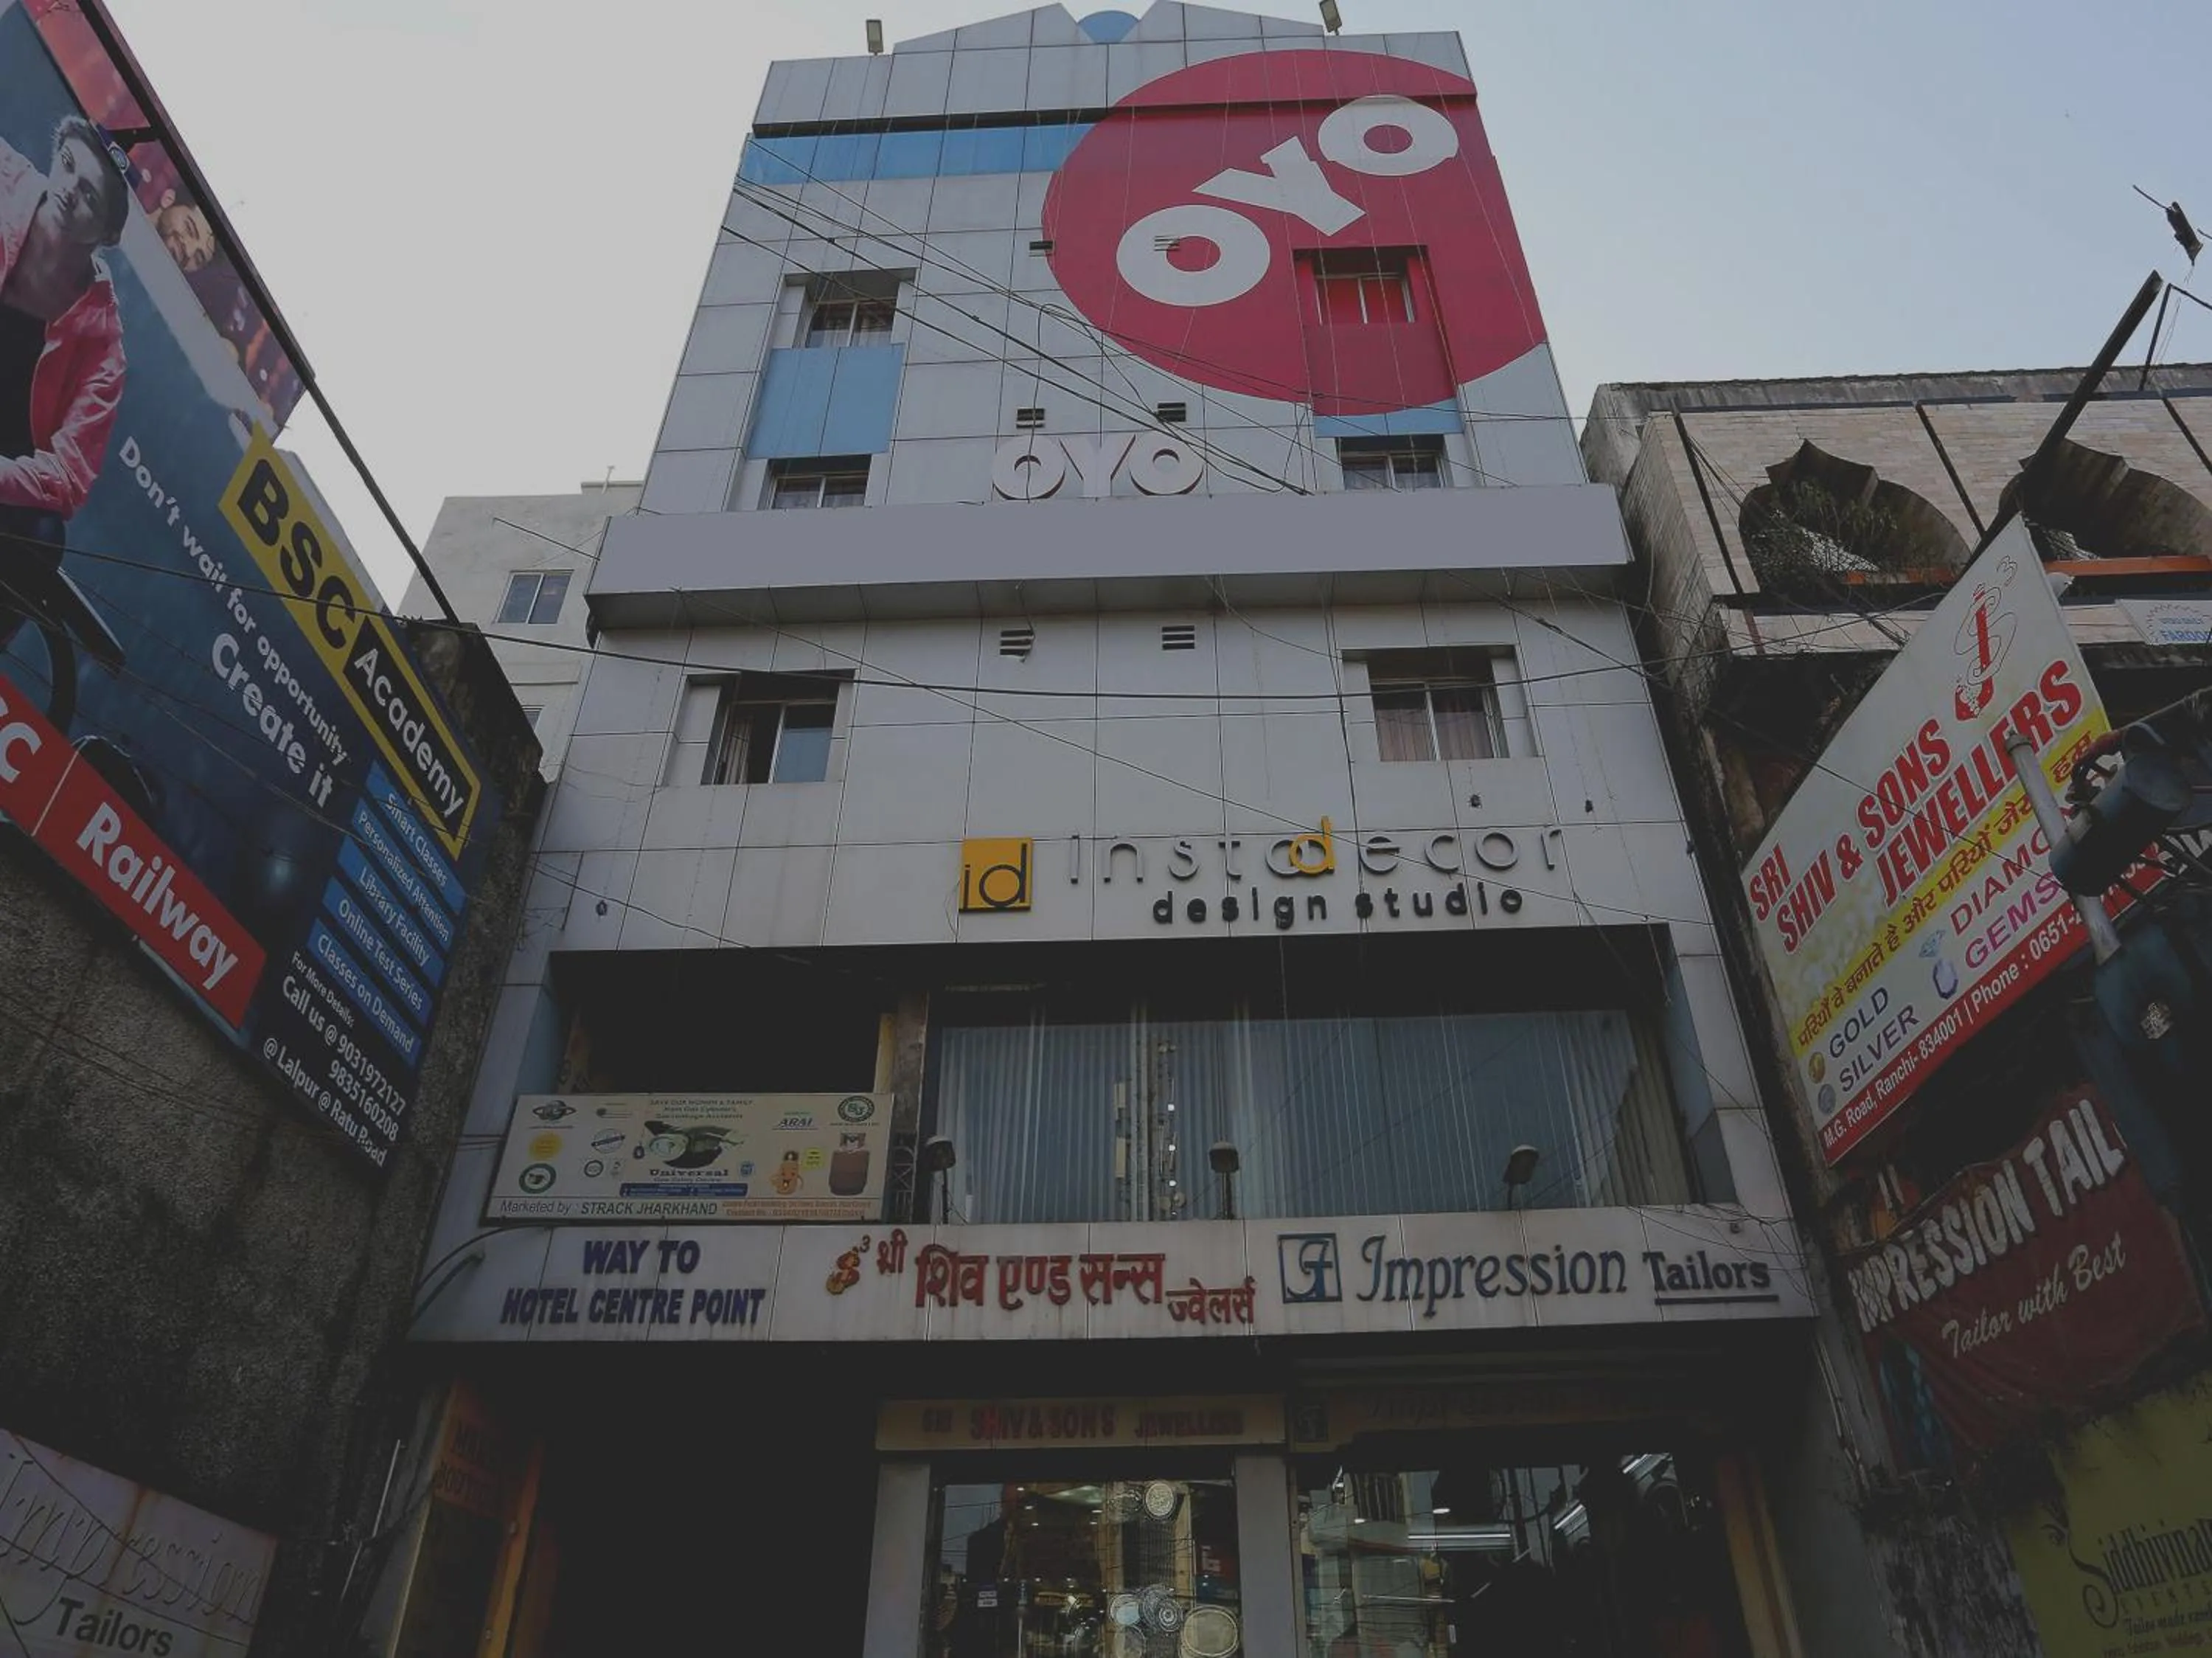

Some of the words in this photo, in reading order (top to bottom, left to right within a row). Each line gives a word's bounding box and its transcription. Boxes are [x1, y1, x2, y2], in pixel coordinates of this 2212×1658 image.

[1116, 94, 1459, 307] OYO
[992, 434, 1203, 500] OYO
[119, 436, 179, 526] Don't
[183, 525, 229, 592] wait
[227, 588, 257, 634] for
[257, 635, 349, 767] opportunity
[237, 458, 355, 650] BSC
[212, 632, 306, 774] Create
[308, 763, 333, 808] it
[354, 648, 465, 818] Academy
[1874, 660, 2082, 906] JEWELLERS
[0, 690, 42, 783] C
[76, 802, 239, 991] Railway
[359, 810, 414, 892] Personalized
[413, 884, 451, 941] Attention
[385, 792, 417, 842] Smart
[414, 834, 448, 888] Classes
[961, 842, 1028, 909] id
[1749, 845, 1792, 920] SRI
[1776, 853, 1837, 954] SHIV
[1835, 833, 1864, 881] &
[1857, 718, 1952, 850] SONS
[338, 898, 375, 949] Online
[374, 939, 395, 976] Test
[393, 966, 423, 1013] Series
[359, 866, 397, 923] Library
[395, 912, 431, 968] Facility
[1153, 889, 1328, 930] design
[1354, 880, 1524, 920] studio
[1964, 869, 2062, 971] GEMS
[291, 950, 307, 977] For
[305, 969, 327, 999] More
[317, 934, 358, 990] Classes
[357, 982, 372, 1007] on
[372, 996, 414, 1054] Demand
[1829, 987, 1888, 1058] GOLD
[282, 975, 310, 1013] Call
[307, 1005, 327, 1034] us
[338, 1033, 407, 1117] 9031972127
[1823, 1120, 1847, 1148] M.G.
[1846, 1094, 1878, 1129] Road,
[1875, 1048, 1920, 1100] Ranchi-
[1919, 1009, 1964, 1061] 834001
[1972, 962, 2020, 1013] Phone
[1839, 1005, 1920, 1092] SILVER
[276, 1044, 321, 1101] Lalpur
[329, 1098, 360, 1138] Ratu
[355, 1127, 389, 1170] Road
[327, 1058, 400, 1142] 9835160208
[500, 1199, 555, 1214] Marketed
[557, 1201, 573, 1217] by
[580, 1202, 633, 1215] STRACK
[635, 1201, 717, 1216] JHARKHAND
[650, 1169, 728, 1177] Universal
[1847, 1159, 2037, 1333] IMPRESSION
[2023, 1099, 2129, 1217] TAIL
[498, 1287, 579, 1325] HOTEL
[588, 1288, 685, 1325] CENTRE
[689, 1288, 767, 1326] POINT
[582, 1238, 650, 1276] WAY
[656, 1239, 702, 1276] TO
[915, 1244, 989, 1307] शिव
[998, 1255, 1074, 1311] एण्ड
[1079, 1253, 1166, 1305] सन्स
[1356, 1234, 1628, 1319] Impression
[1642, 1251, 1771, 1293] Tailors
[1941, 1308, 2014, 1359] Tailor
[2017, 1262, 2070, 1325] with
[2067, 1230, 2128, 1293] Best
[56, 1597, 175, 1658] Tailors
